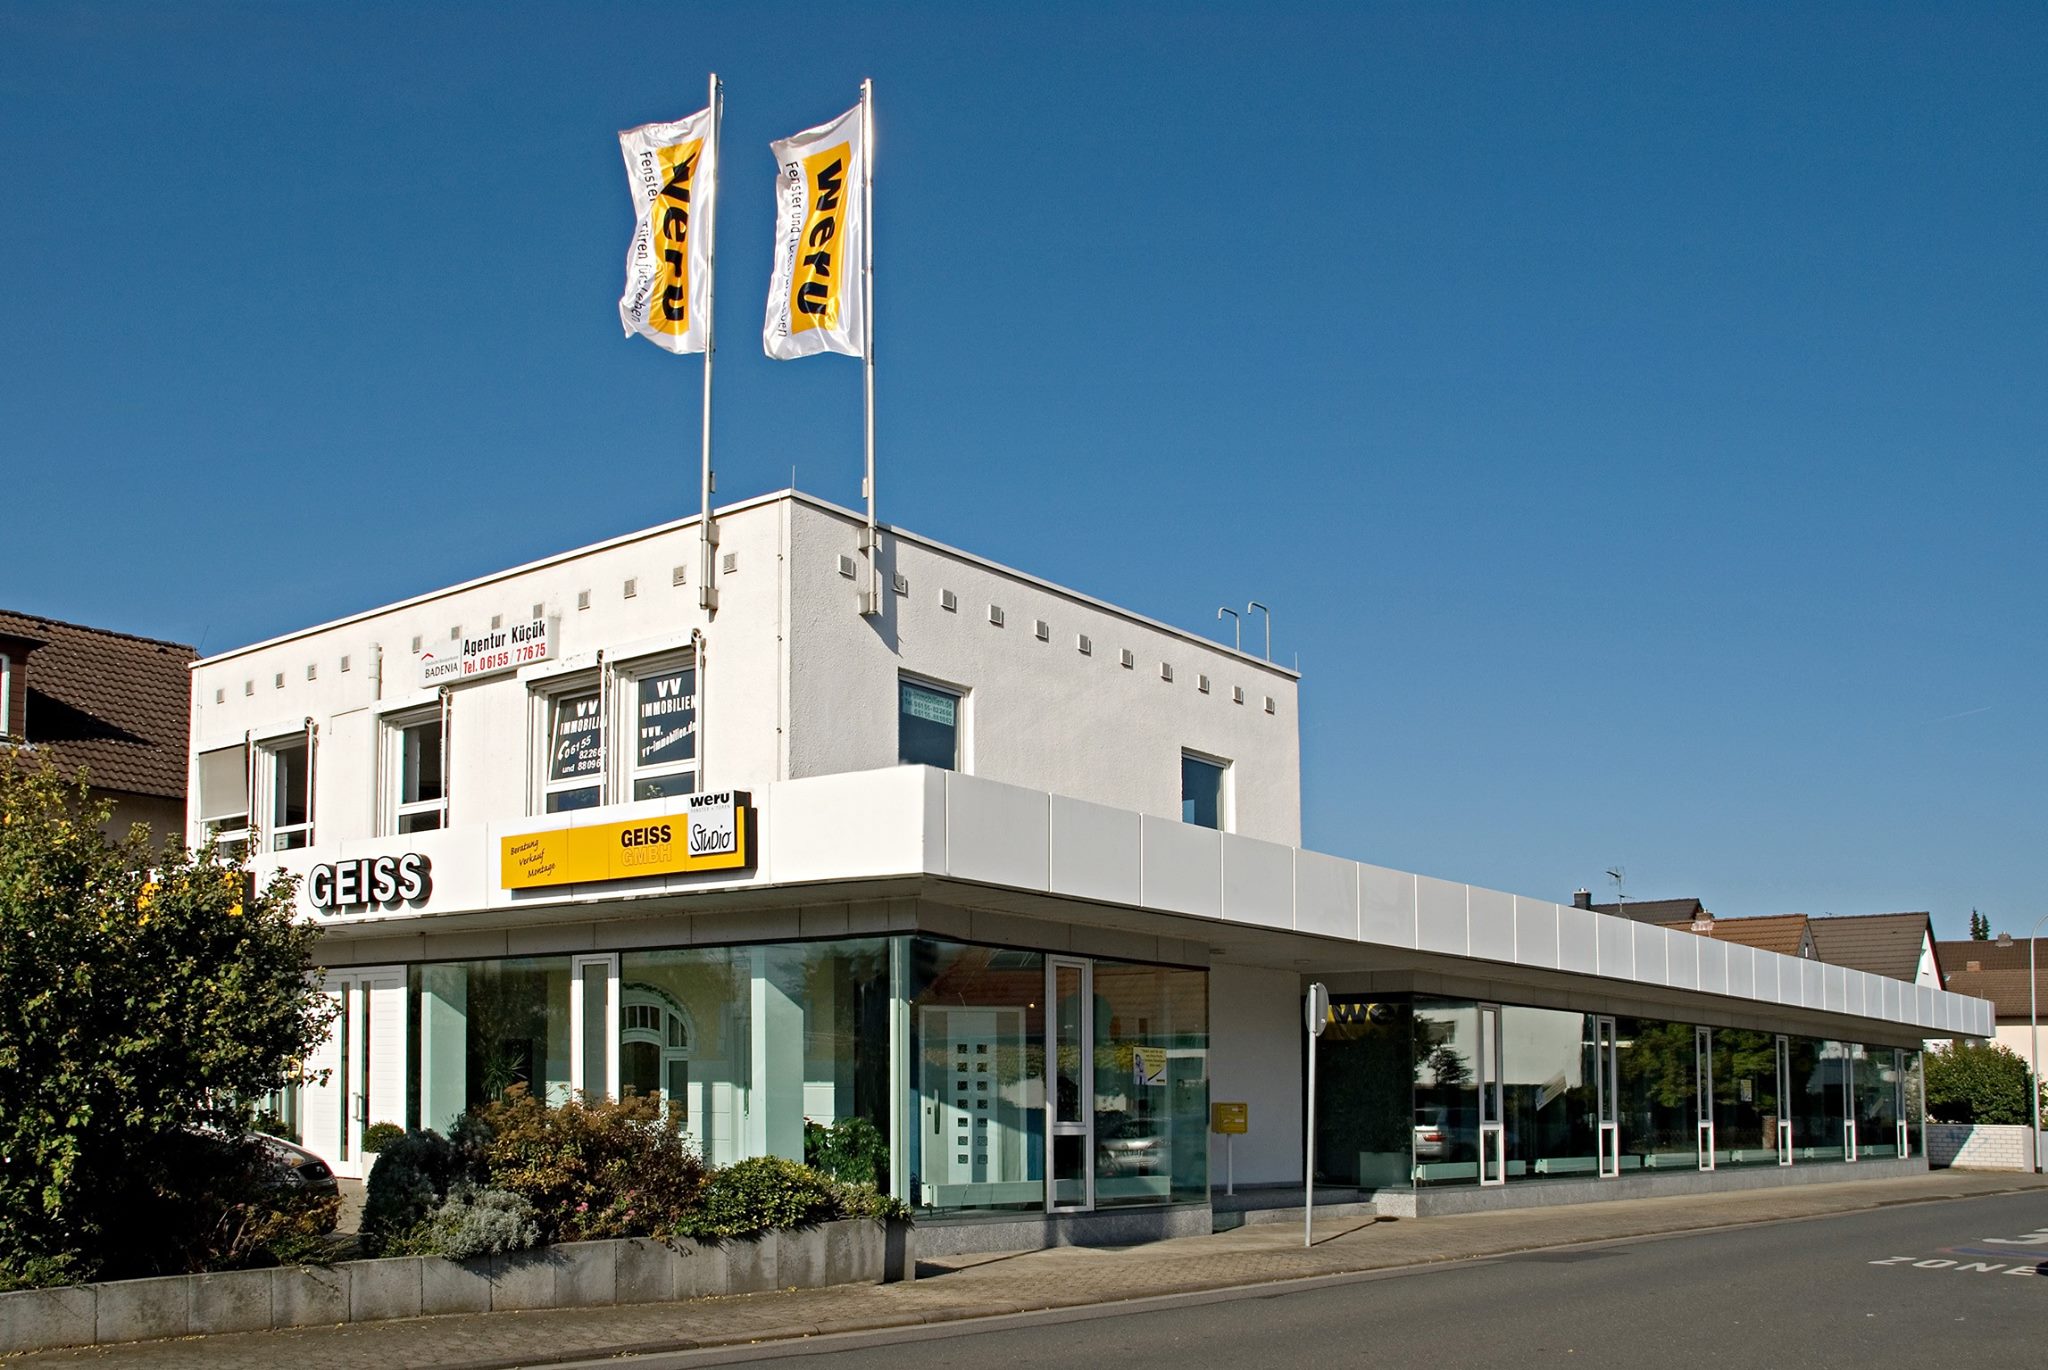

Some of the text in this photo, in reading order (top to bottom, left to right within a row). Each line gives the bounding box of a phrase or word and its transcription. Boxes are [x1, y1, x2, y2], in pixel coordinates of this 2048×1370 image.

[786, 161, 803, 209] Fenster
[790, 212, 801, 233] und
[797, 158, 842, 315] weru
[463, 620, 546, 657] Agentur Küçük
[425, 662, 459, 678] BADENIA
[463, 661, 478, 674] Tel.
[641, 694, 696, 718] IMMOBILIEN
[560, 715, 606, 735] IMMOBILI
[562, 764, 575, 773] und
[690, 792, 730, 807] weru
[621, 825, 672, 848] GEISS
[510, 839, 539, 856] Beratung
[519, 848, 545, 866] Verkauf
[621, 844, 673, 867] GMBH
[308, 853, 424, 908] GEISS
[527, 863, 555, 878] Montage
[1868, 1256, 2038, 1277] ZONE
